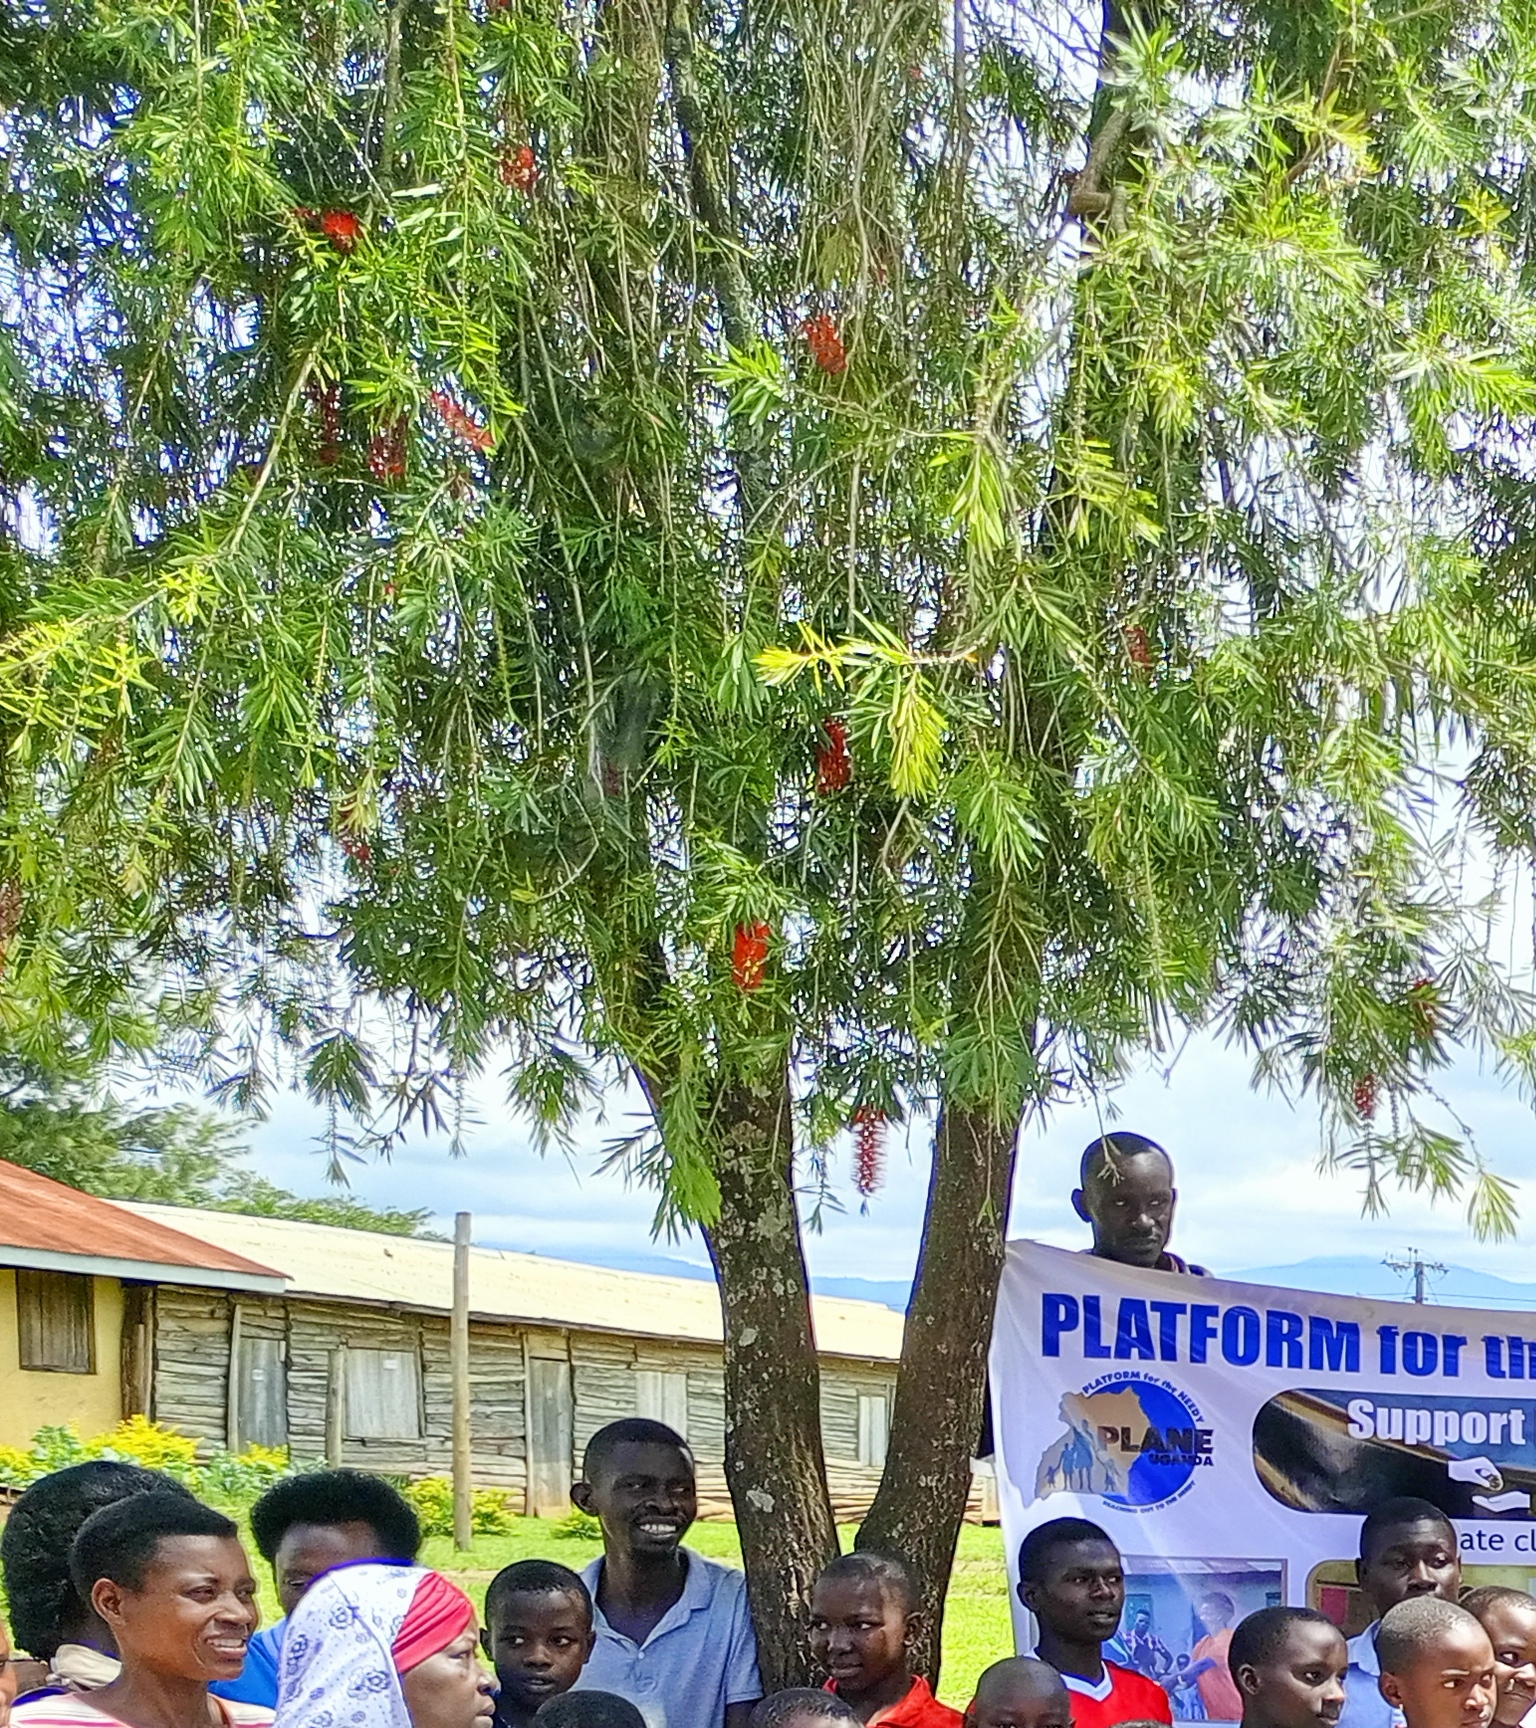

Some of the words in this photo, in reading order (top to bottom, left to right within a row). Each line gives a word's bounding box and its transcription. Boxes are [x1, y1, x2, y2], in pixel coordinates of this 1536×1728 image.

[1041, 1293, 1361, 1375] PLATFORM
[1377, 1326, 1468, 1377] for
[1082, 1371, 1140, 1394] PLATFORM
[1143, 1373, 1160, 1383] for
[1161, 1380, 1177, 1393] the
[1178, 1392, 1204, 1422] NEEDY
[1097, 1425, 1214, 1454] PLANE
[1347, 1399, 1525, 1446] Support
[1149, 1453, 1214, 1466] UGANDA
